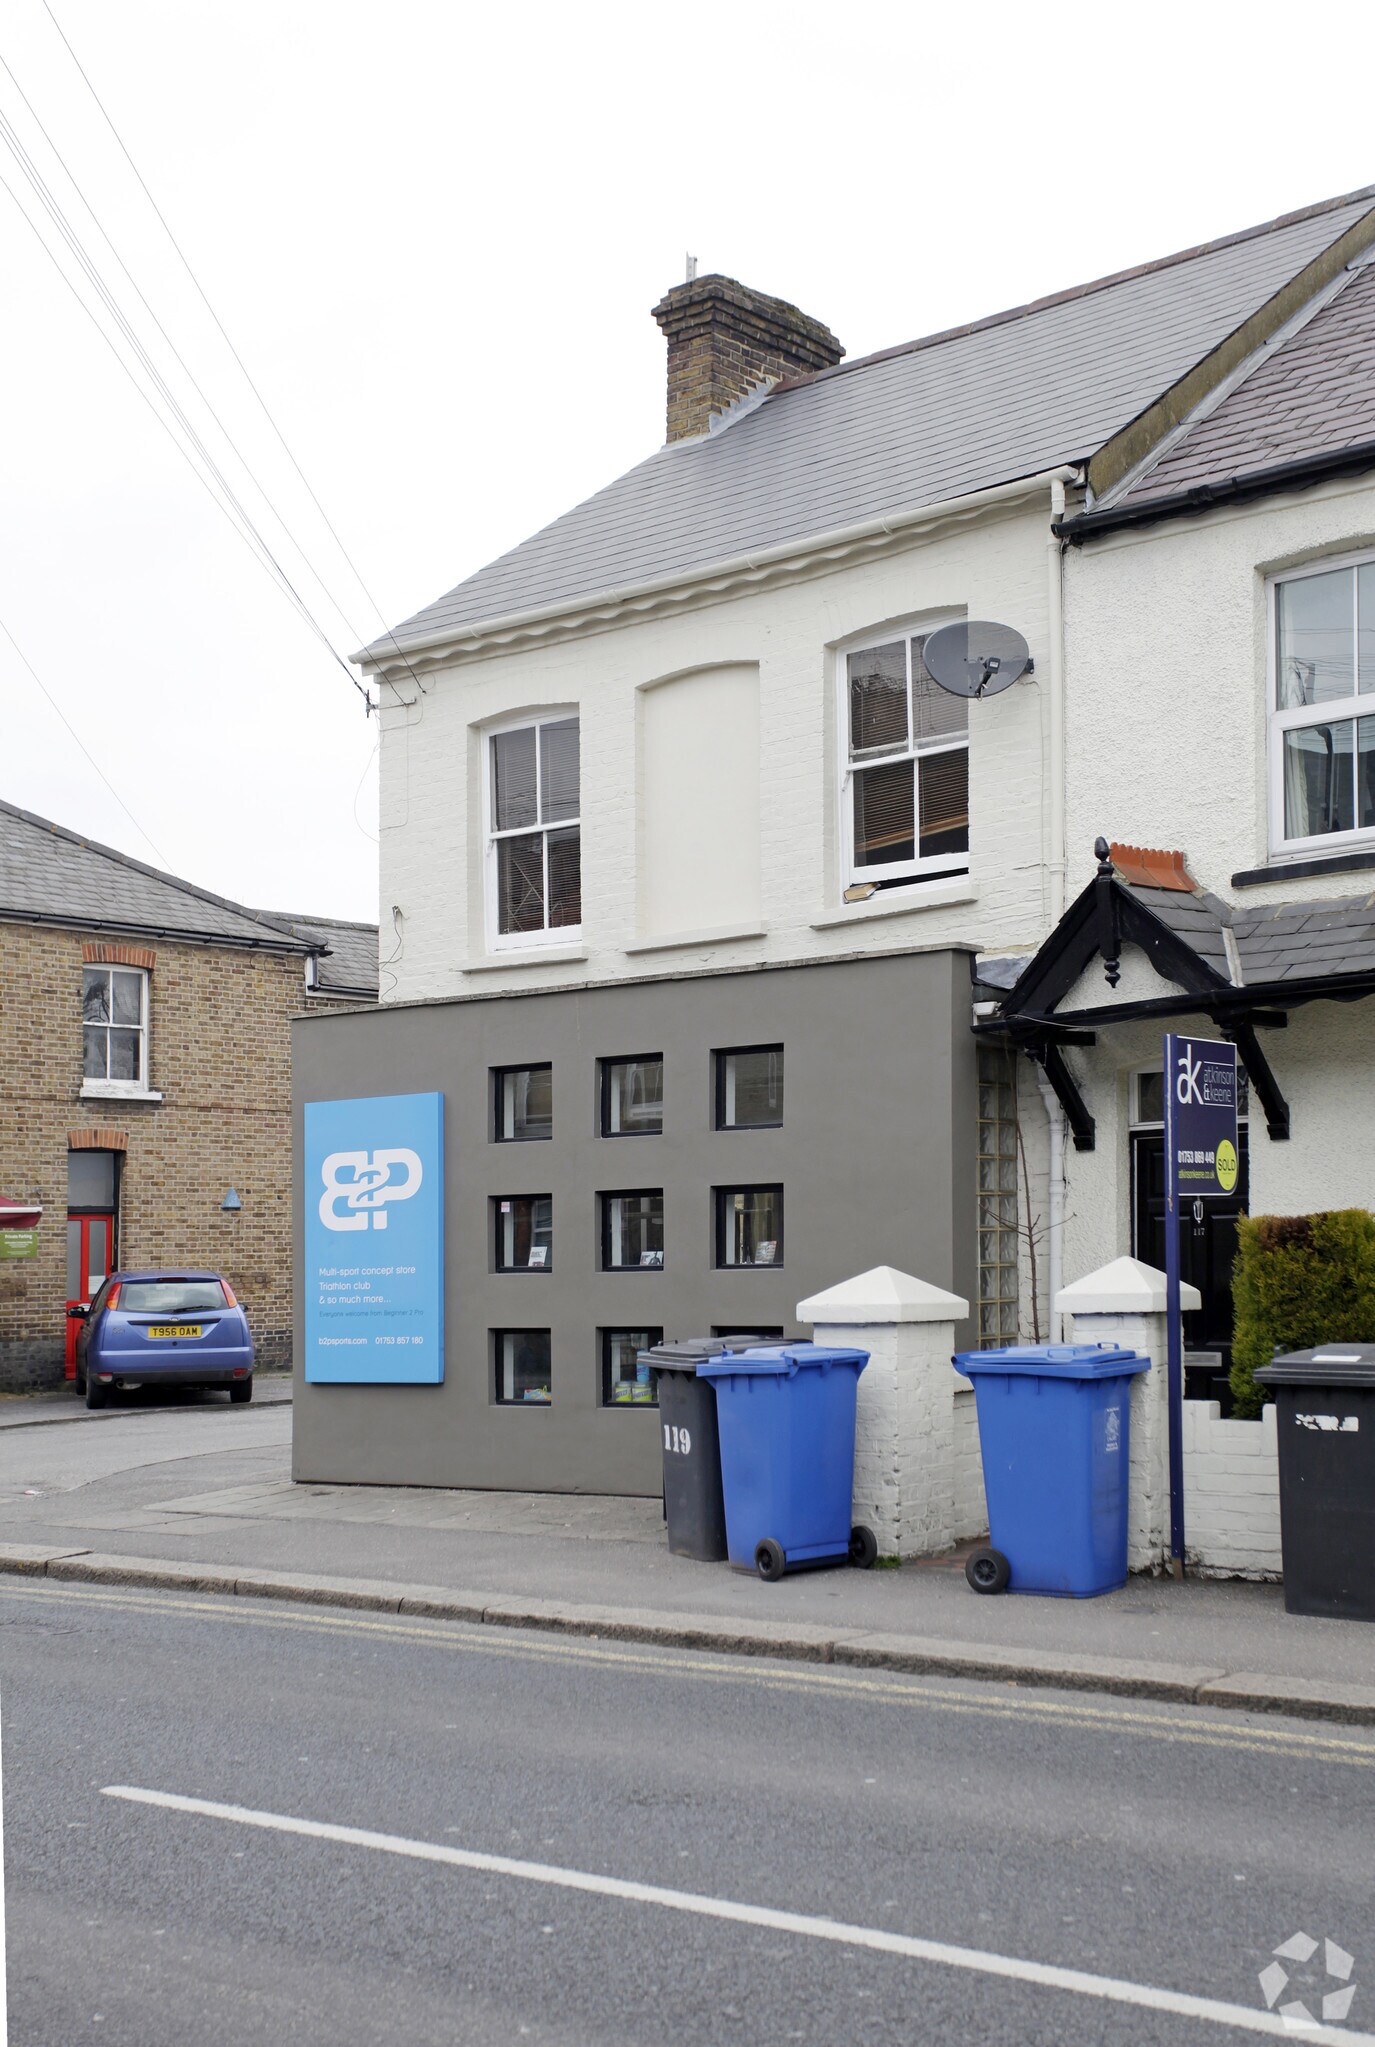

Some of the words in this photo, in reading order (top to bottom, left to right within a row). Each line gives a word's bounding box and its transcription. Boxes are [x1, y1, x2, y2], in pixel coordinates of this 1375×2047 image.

[1203, 1066, 1234, 1085] atkinson
[1177, 1150, 1194, 1163] 01753
[1217, 1158, 1236, 1171] SOLD
[1193, 1228, 1205, 1236] 117
[319, 1267, 359, 1278] Multi-sport
[361, 1267, 393, 1276] concept
[396, 1265, 416, 1274] store
[319, 1282, 351, 1291] Triathlon
[353, 1281, 371, 1290] club
[319, 1296, 325, 1304] &
[339, 1296, 361, 1304] much
[363, 1295, 391, 1304] more...
[319, 1311, 344, 1319] Everyone
[383, 1309, 407, 1318] Beginner
[152, 1326, 177, 1336] T956
[180, 1326, 198, 1335] OAM
[318, 1336, 368, 1346] b2psports.com
[375, 1336, 395, 1345] 01753
[396, 1336, 410, 1345] 857
[411, 1336, 424, 1345] 180
[663, 1424, 691, 1455] 119
